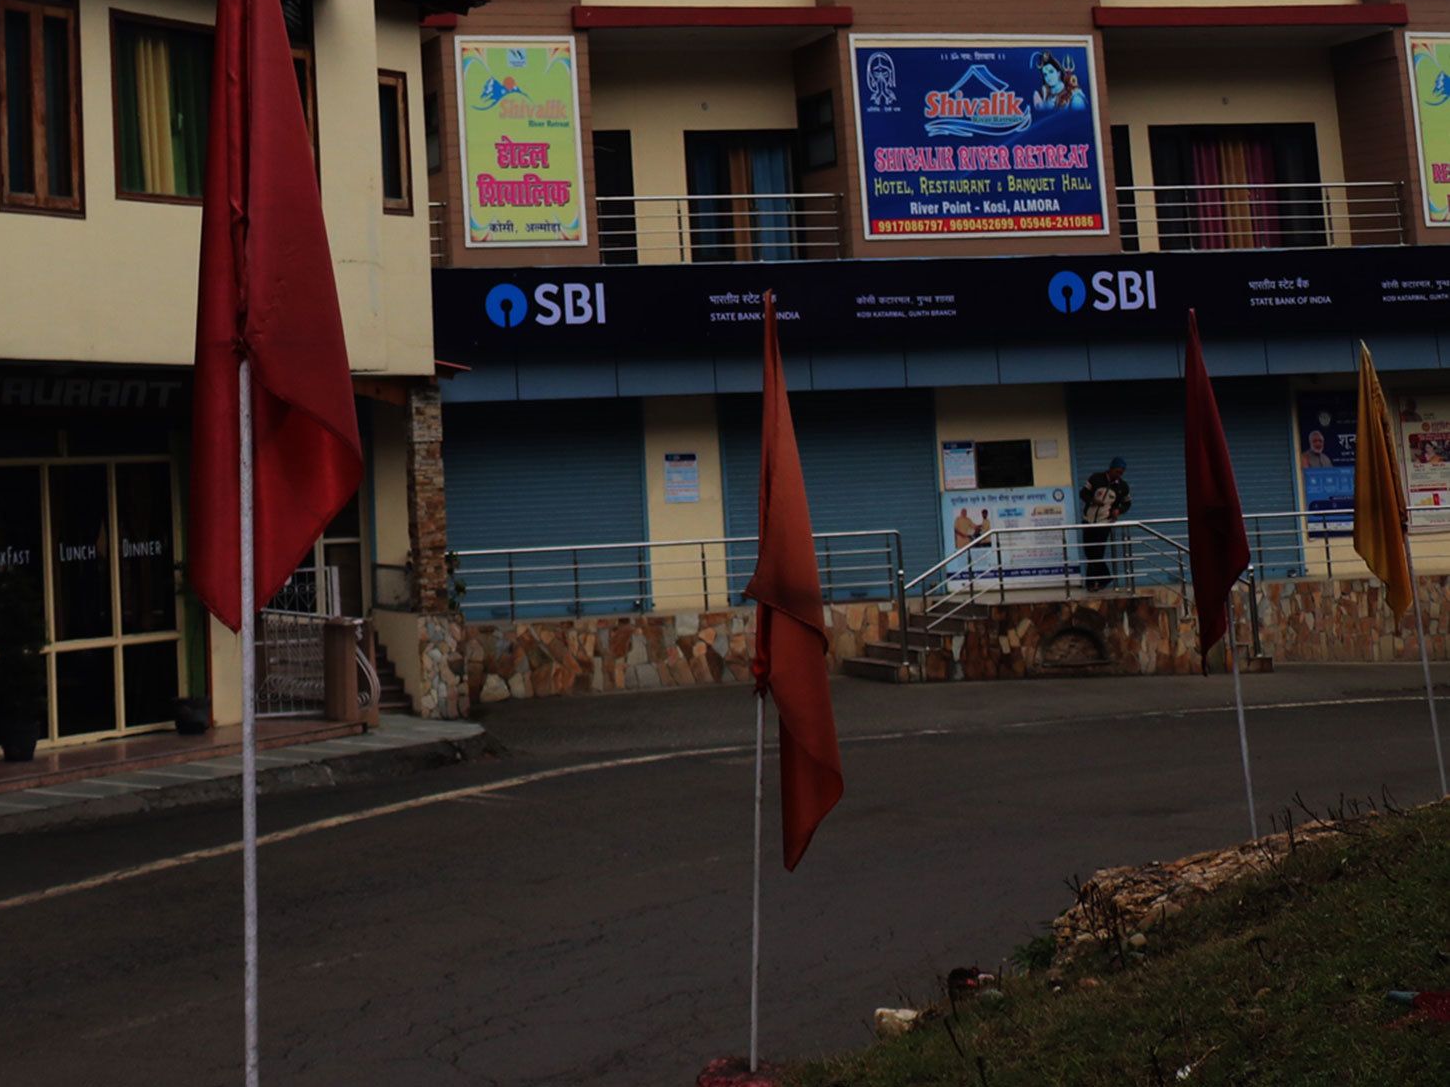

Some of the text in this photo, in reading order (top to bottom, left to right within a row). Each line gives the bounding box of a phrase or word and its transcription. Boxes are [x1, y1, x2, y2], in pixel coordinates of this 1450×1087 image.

[924, 89, 1024, 118] Shivalik
[495, 136, 550, 169] होटल
[874, 144, 1089, 173] SHIVALIK RIVER RETREAT
[476, 173, 572, 208] शिवालिक
[910, 201, 939, 214] River
[942, 200, 972, 214] Point
[983, 200, 1010, 214] Kosi,
[1013, 198, 1061, 212] ALMORA
[534, 283, 607, 327] SBI
[1091, 270, 1158, 312] SBI
[1250, 295, 1333, 307] STATE BANK OF INDIA
[710, 311, 736, 322] STATE
[737, 311, 762, 321] BANK
[775, 311, 801, 321] INDIA
